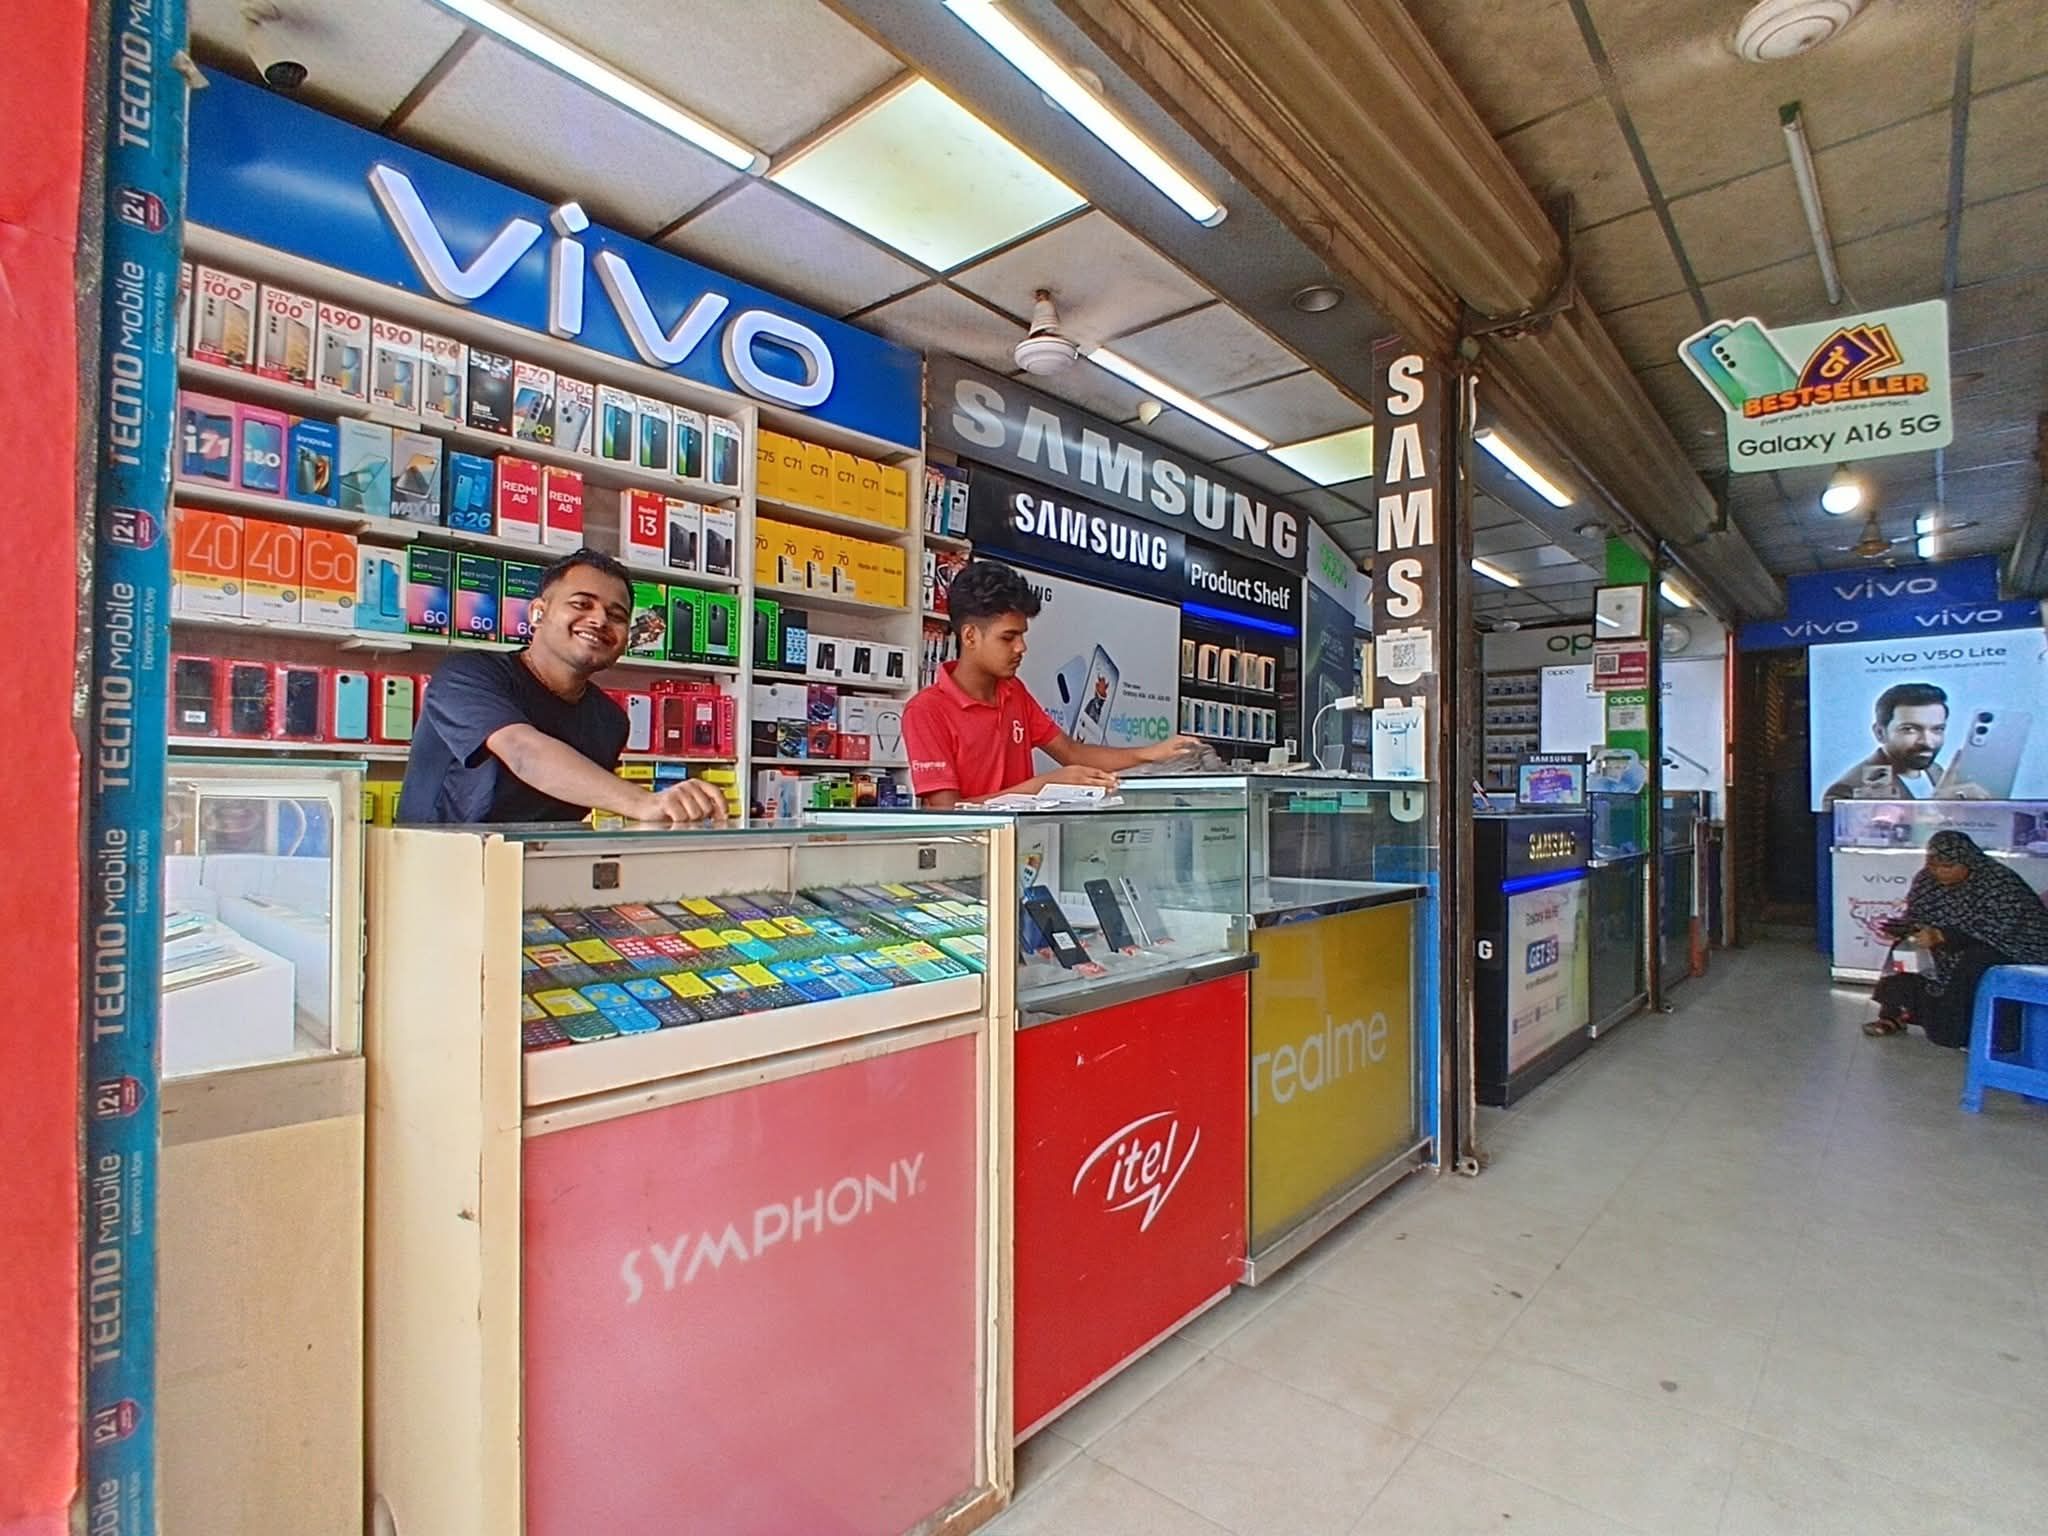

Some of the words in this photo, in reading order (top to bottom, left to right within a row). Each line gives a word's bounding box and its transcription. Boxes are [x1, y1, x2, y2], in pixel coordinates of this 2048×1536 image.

[120, 31, 151, 149] TECNO
[202, 271, 231, 284] CITY
[368, 163, 835, 408] vivo
[202, 280, 242, 301] 100
[266, 299, 304, 319] 100
[319, 307, 361, 330] A90
[373, 323, 413, 345] A90
[1742, 373, 1930, 420] BESTSELLER
[110, 352, 143, 468] TECNO
[1737, 431, 1837, 456] Galaxy
[1845, 420, 1892, 445] A16
[1900, 414, 1942, 436] 5G
[783, 456, 802, 470] C71
[810, 464, 829, 478] C71
[951, 379, 1298, 560] SAMSUNG
[502, 480, 538, 496] REDMI
[837, 471, 856, 484] C71
[862, 478, 880, 491] C71
[549, 490, 582, 505] REDMI
[638, 515, 657, 536] 13
[1014, 492, 1169, 571] SAMSUNG
[187, 521, 238, 570] 40
[247, 531, 296, 578] 40
[783, 543, 797, 556] 70
[811, 548, 825, 561] 70
[307, 540, 355, 584] Go
[837, 554, 849, 566] 70
[1191, 563, 1251, 601] Product
[1253, 581, 1290, 610] Shelf
[1834, 577, 1937, 600] vivo
[105, 583, 135, 670] Mobile
[423, 610, 448, 625] 60
[471, 616, 493, 630] 60
[1915, 609, 2003, 627] vivo
[1782, 620, 1859, 638] vivo
[1865, 652, 1917, 665] vivo
[1922, 648, 1964, 661] V50
[1968, 646, 2007, 658] Lite
[1609, 695, 1645, 704] oppo
[100, 676, 133, 793] TECNO
[1375, 717, 1421, 732] NEW
[1529, 755, 1574, 763] SAMSUNG
[98, 829, 128, 916] Mobile
[1863, 873, 1907, 884] vivo
[94, 923, 127, 1042] TECNO
[1251, 1010, 1388, 1115] realme
[1106, 1120, 1179, 1201] itel
[93, 1154, 121, 1244] Mobile
[620, 1152, 924, 1305] SYMPHONY
[90, 1249, 121, 1371] TECNO
